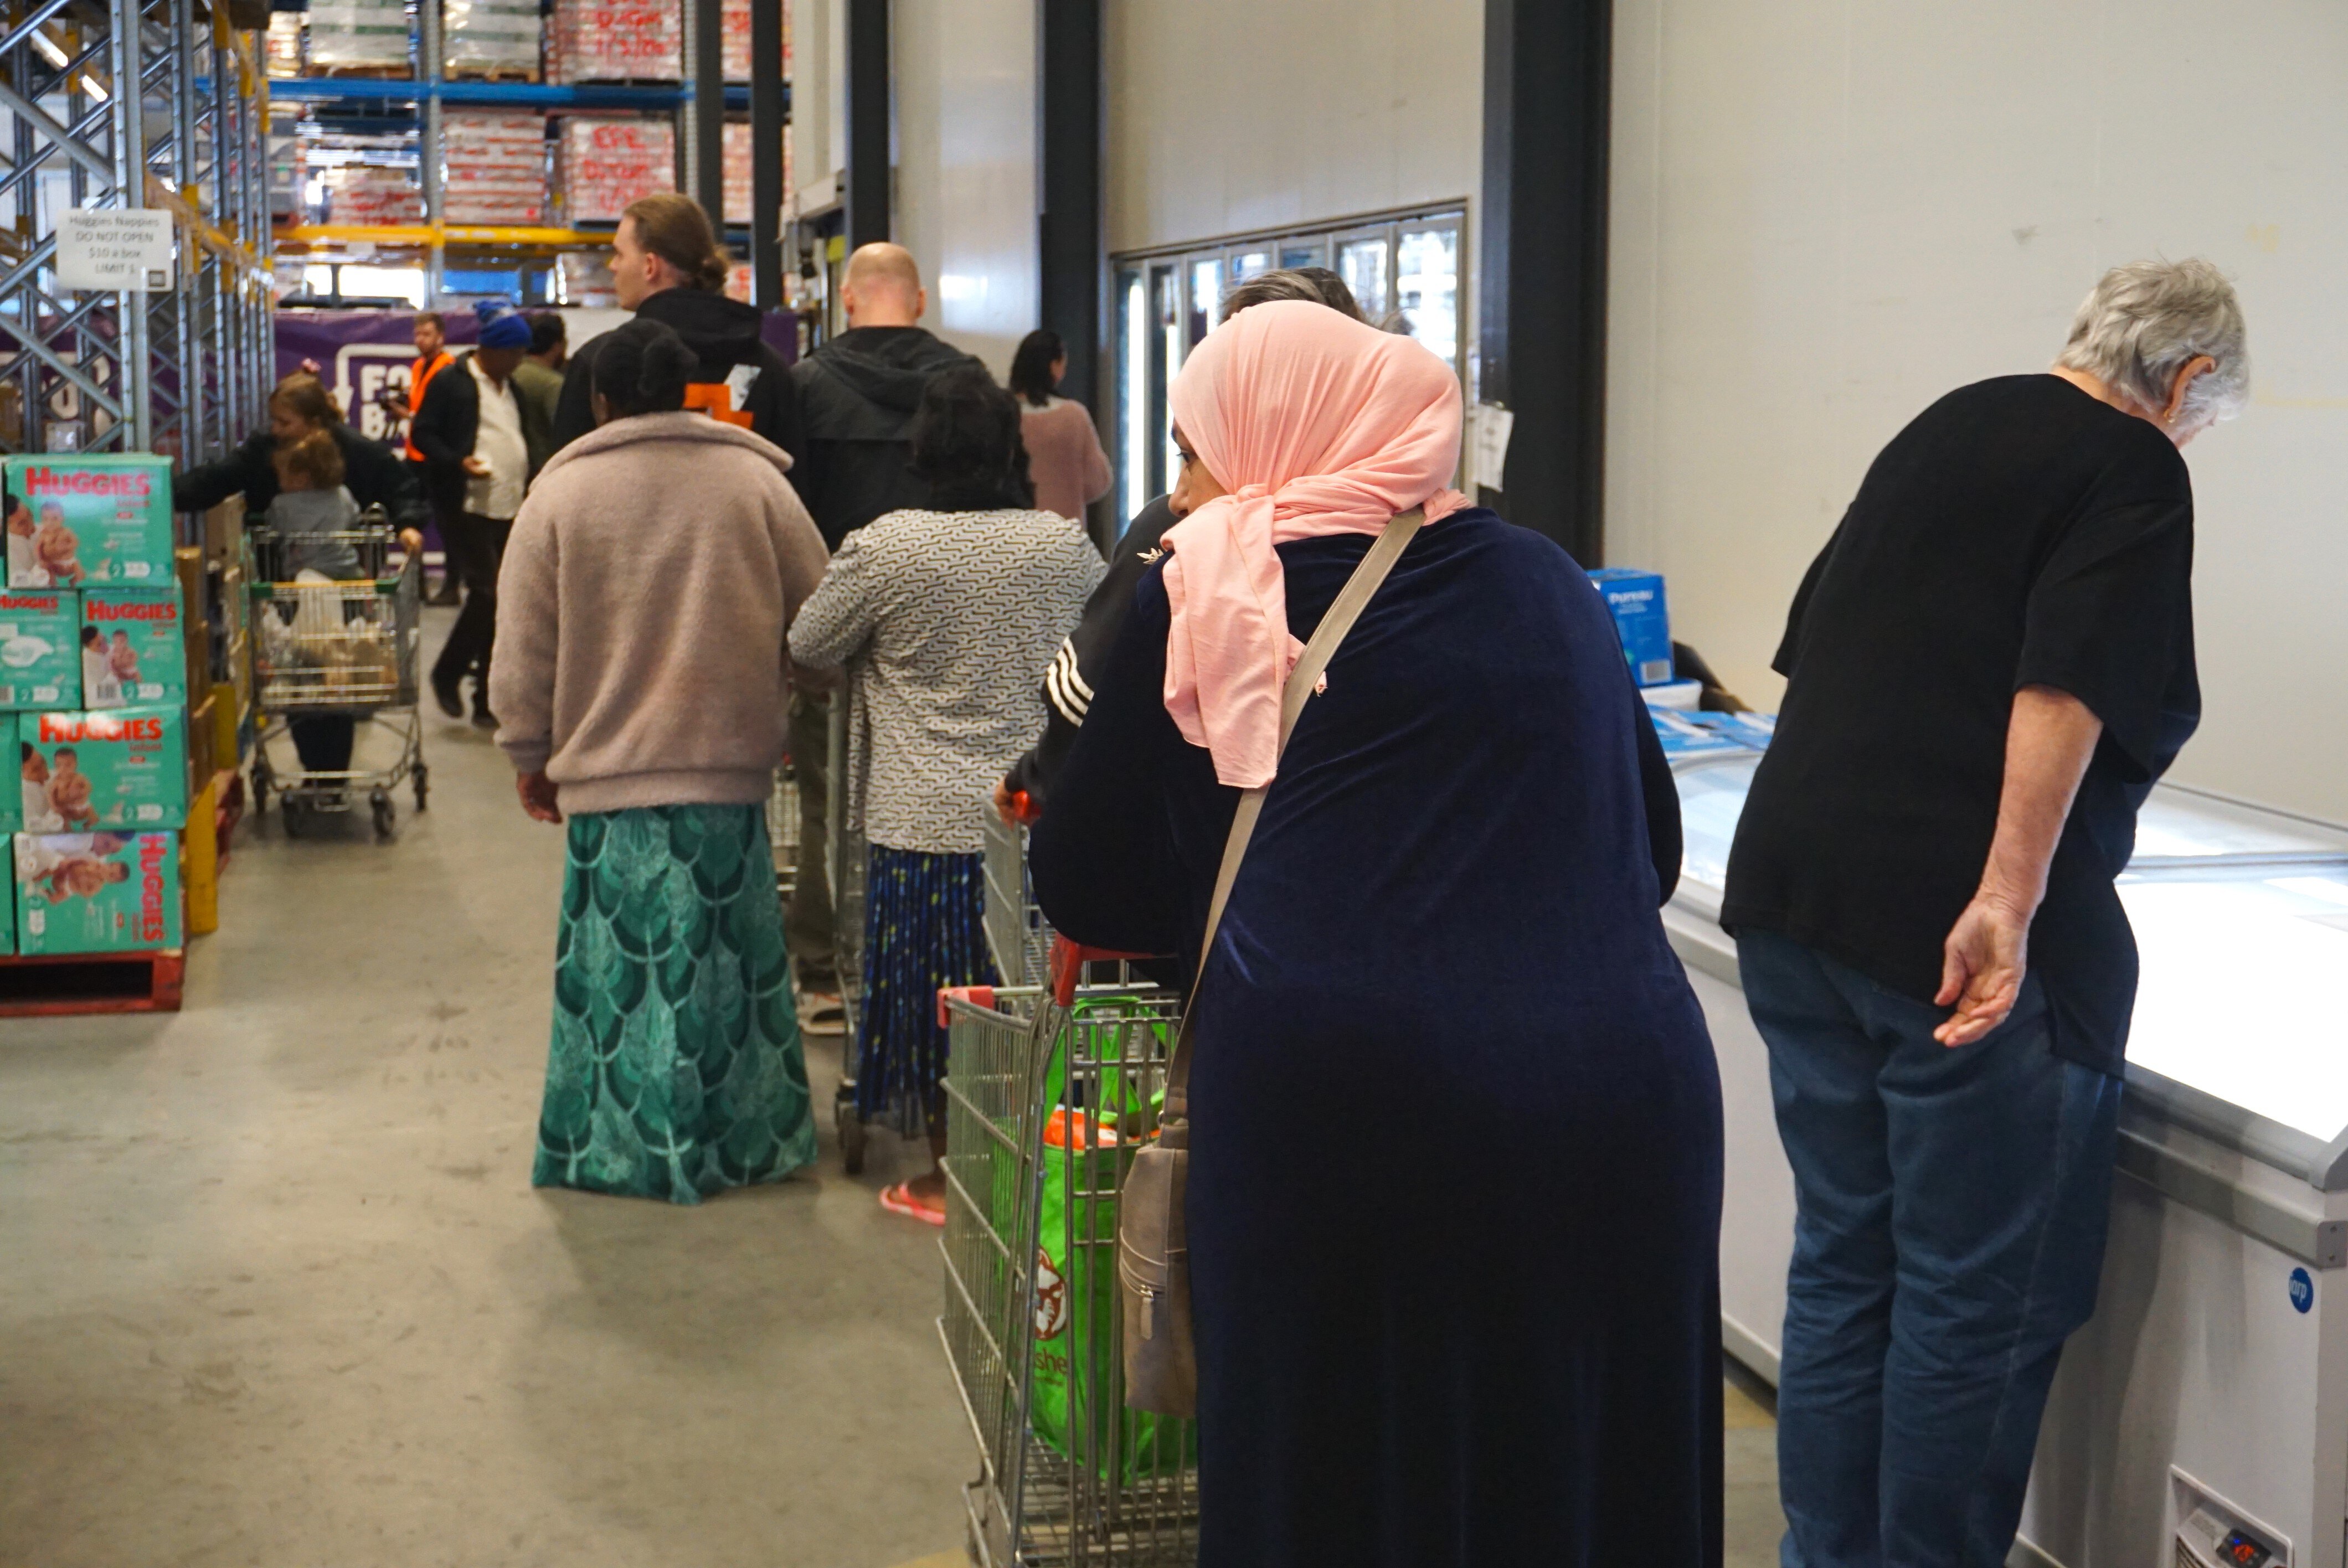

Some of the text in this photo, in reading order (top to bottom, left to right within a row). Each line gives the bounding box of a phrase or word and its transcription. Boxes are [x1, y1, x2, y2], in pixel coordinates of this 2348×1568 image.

[70, 216, 159, 227] Huggies Nappies
[75, 230, 154, 243] DO NOT OPEN
[121, 247, 141, 259] box
[96, 264, 124, 274] LIMIT
[25, 466, 150, 497] HUGGIES
[86, 600, 177, 621] HUGGIES
[39, 714, 163, 744] HUGGIES
[140, 835, 166, 942] HUGGIES
